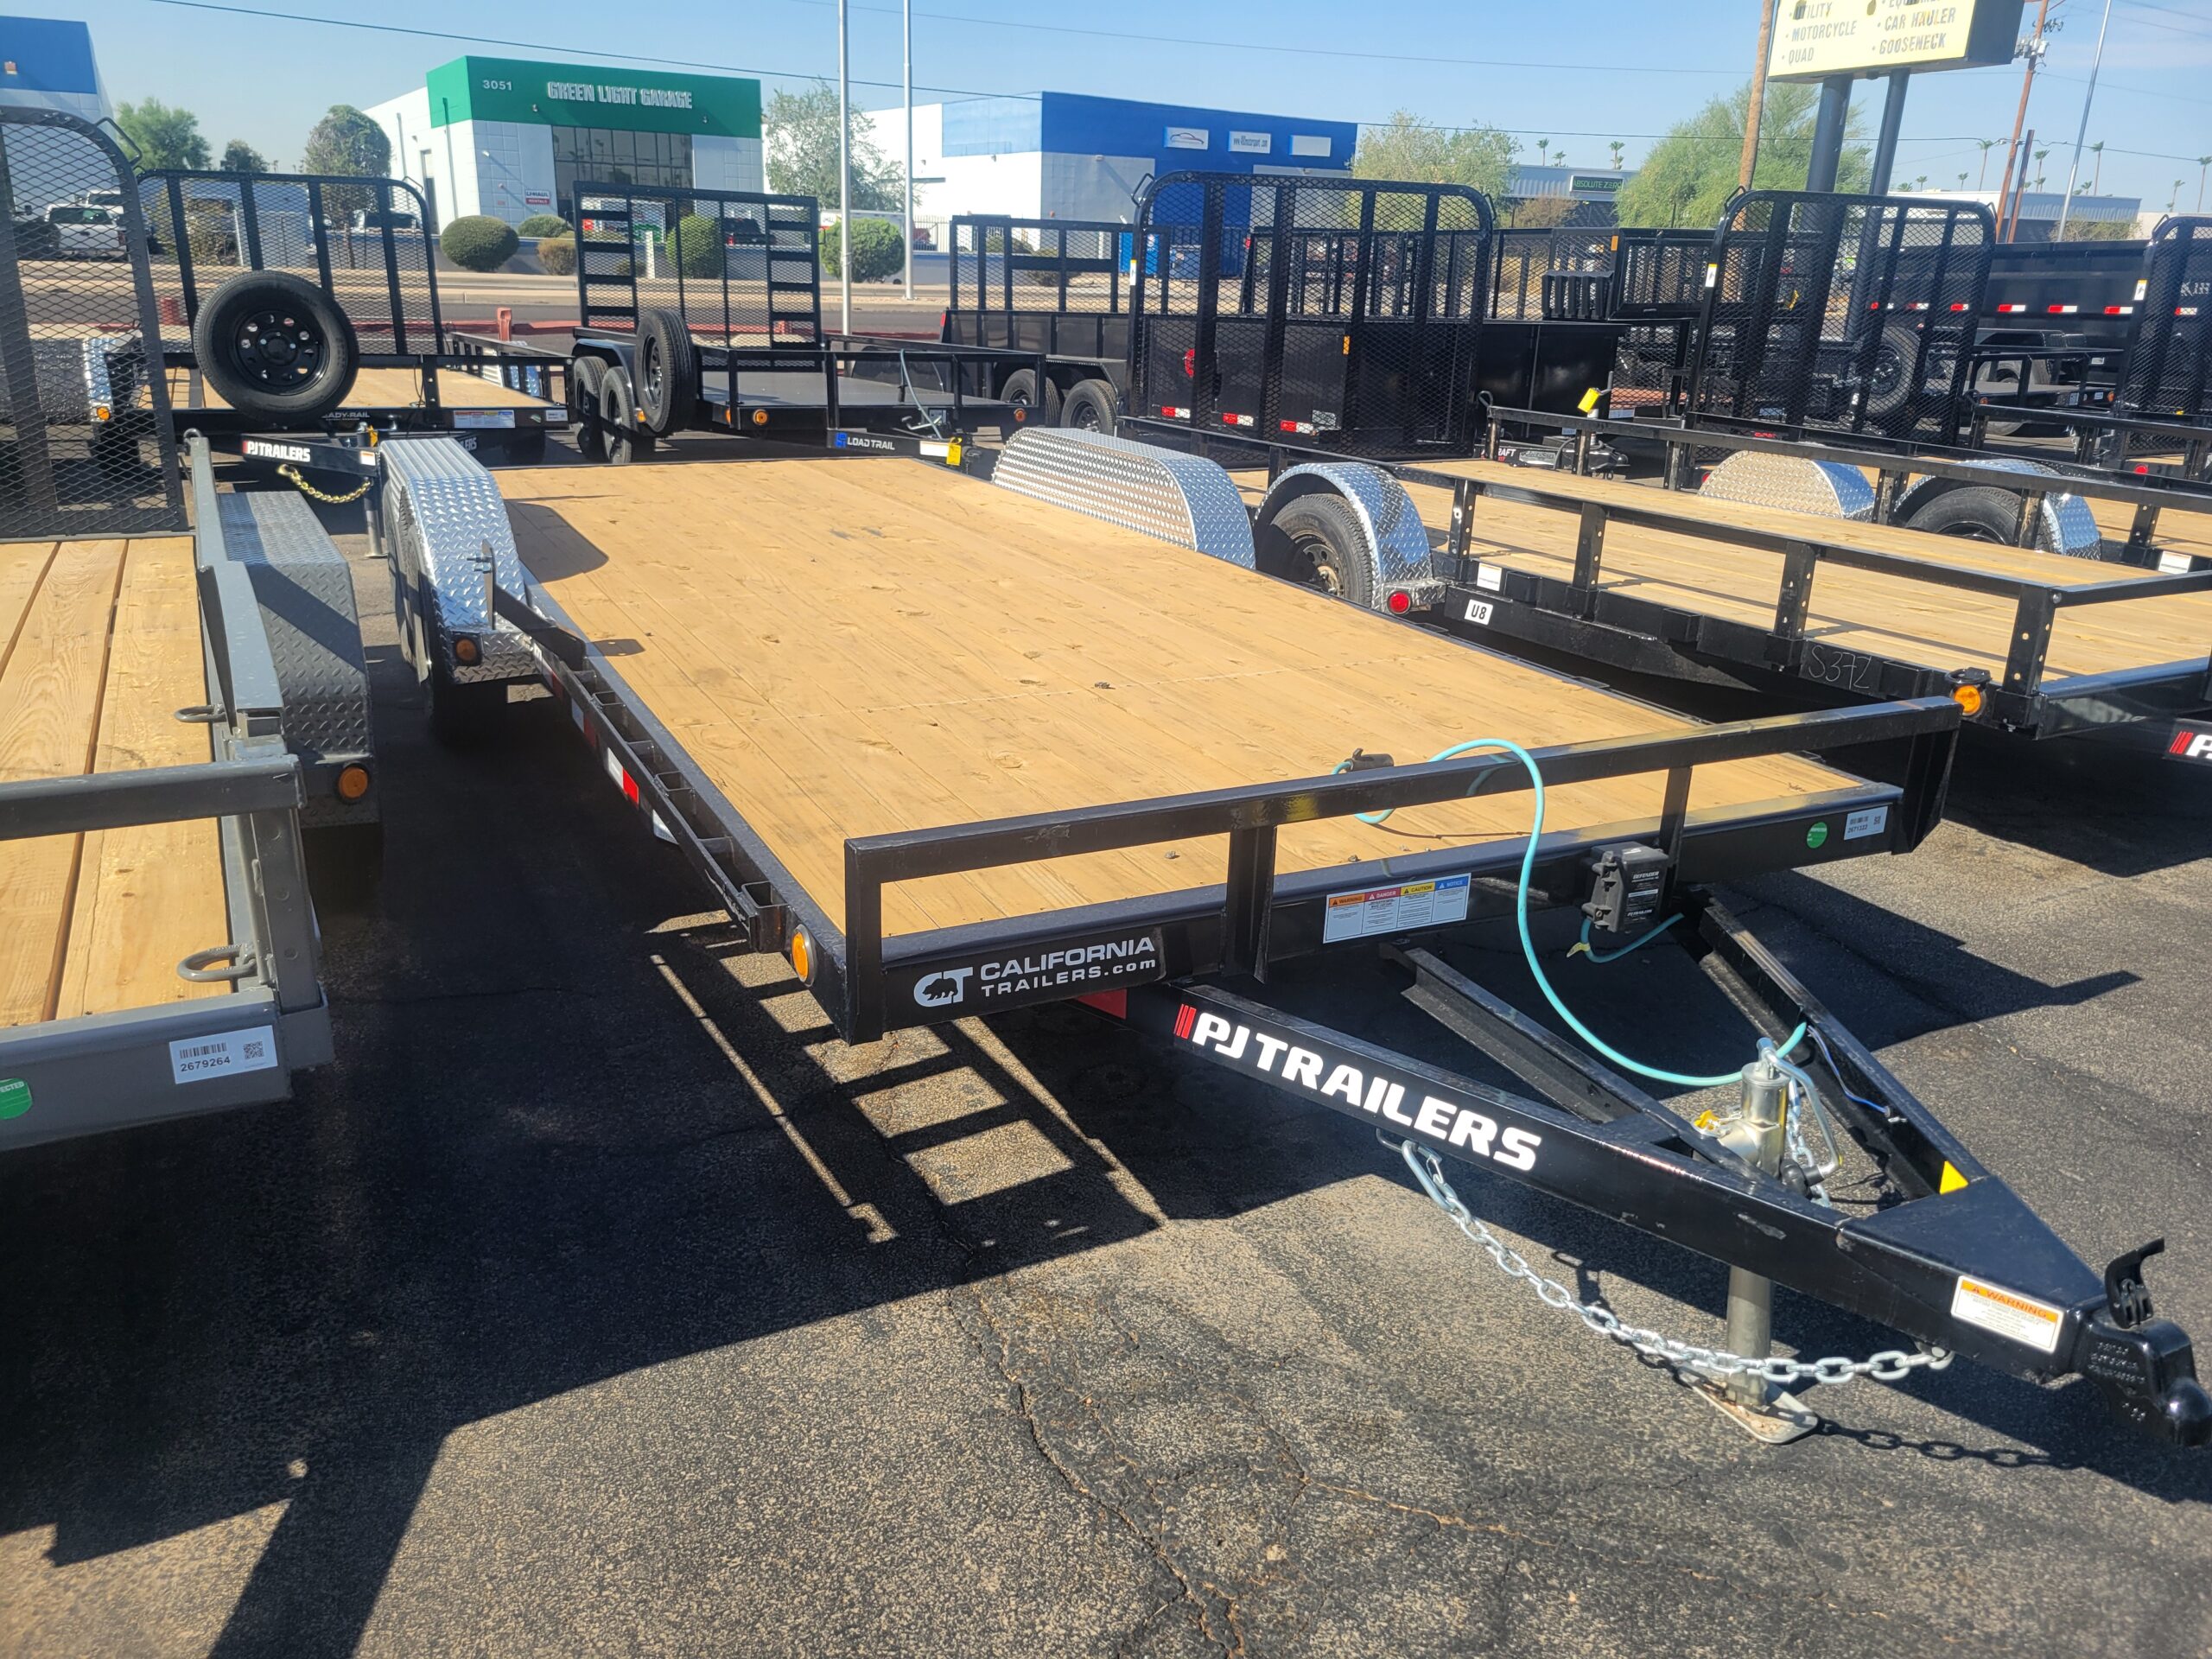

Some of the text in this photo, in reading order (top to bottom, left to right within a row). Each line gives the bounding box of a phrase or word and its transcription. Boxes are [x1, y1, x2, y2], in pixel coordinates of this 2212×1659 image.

[1793, 3, 1832, 20] UTILITY
[1885, 7, 1956, 31] CAR HAULER
[1791, 21, 1857, 41] MOTORCYCLE
[1879, 33, 1947, 54] GOOSENECK
[1789, 47, 1815, 66] QUAD
[483, 79, 512, 91] 3051
[547, 81, 693, 109] GREEN LIGHT GARAGE
[1573, 180, 1602, 188] ABSOLUTE
[246, 440, 311, 462] PJ TRAILERS
[847, 436, 895, 451] LOAD TRAIL
[1471, 604, 1487, 620] U8
[1632, 870, 1660, 880] DEFENDER
[1376, 890, 1396, 899] DANGER
[1411, 884, 1433, 893] CAUTION
[1339, 895, 1363, 904] WARNING
[980, 937, 1155, 981] CALIFORNIA
[981, 959, 1156, 997] TRAILERS.com
[180, 1056, 231, 1072] 2679264
[1192, 1012, 1542, 1172] PJ TRAILERS
[1986, 1290, 2047, 1318] WARNING
